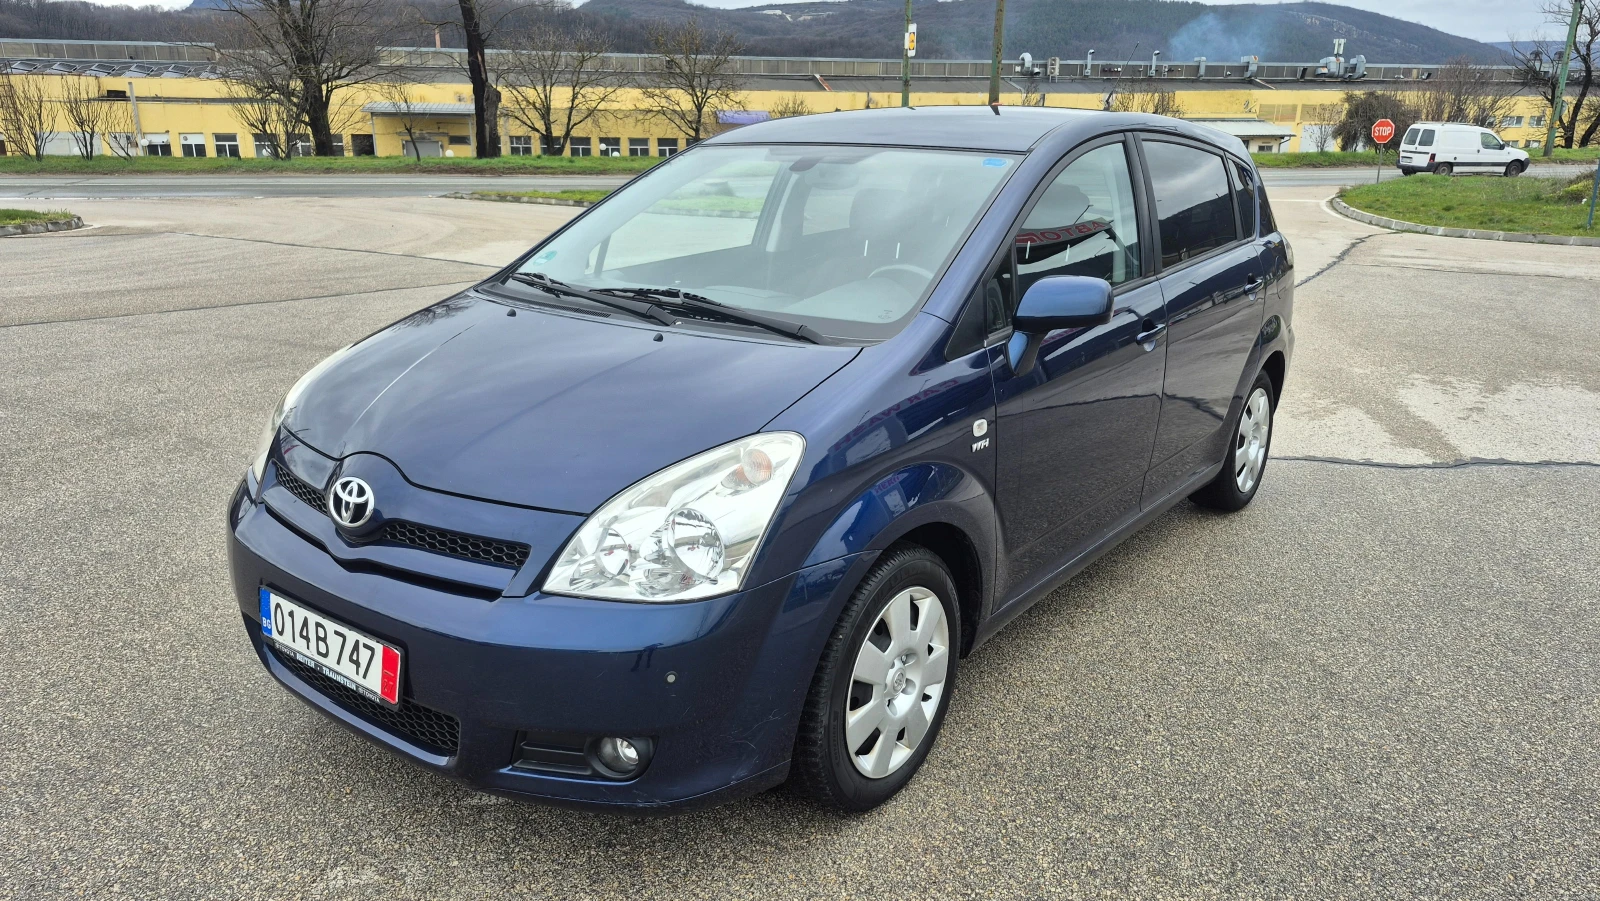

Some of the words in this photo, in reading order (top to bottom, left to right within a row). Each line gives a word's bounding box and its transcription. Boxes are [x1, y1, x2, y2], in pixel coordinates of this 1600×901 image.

[1374, 127, 1391, 136] STOP
[262, 617, 271, 630] BG
[274, 602, 375, 680] 014B747
[297, 653, 314, 668] REITER
[323, 667, 356, 690] TRAUNSTEIN
[363, 690, 380, 703] TOYOTA
